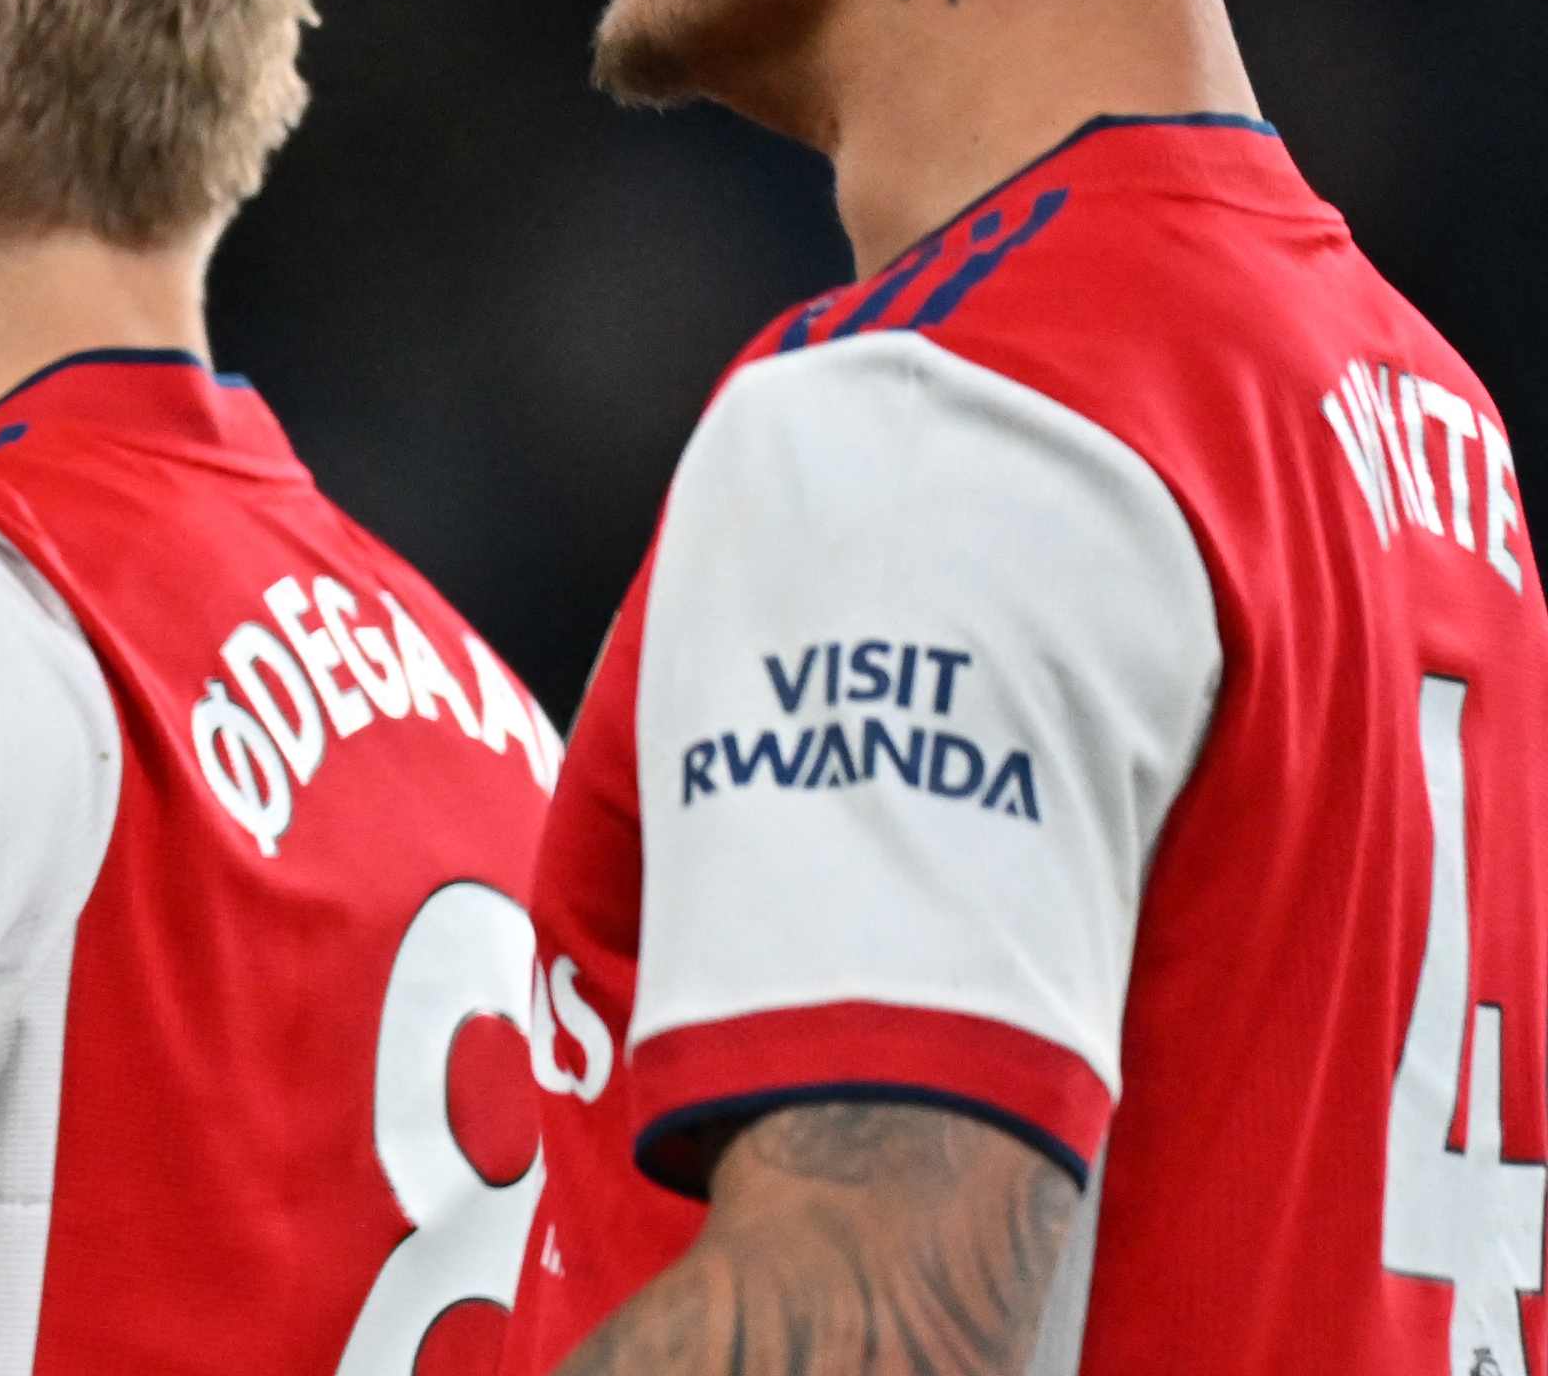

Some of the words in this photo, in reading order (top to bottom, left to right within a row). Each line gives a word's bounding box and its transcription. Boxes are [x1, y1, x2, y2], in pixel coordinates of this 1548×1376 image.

[1321, 357, 1523, 596] WHITE
[763, 638, 972, 716] VISIT
[682, 717, 1042, 823] RWANDA
